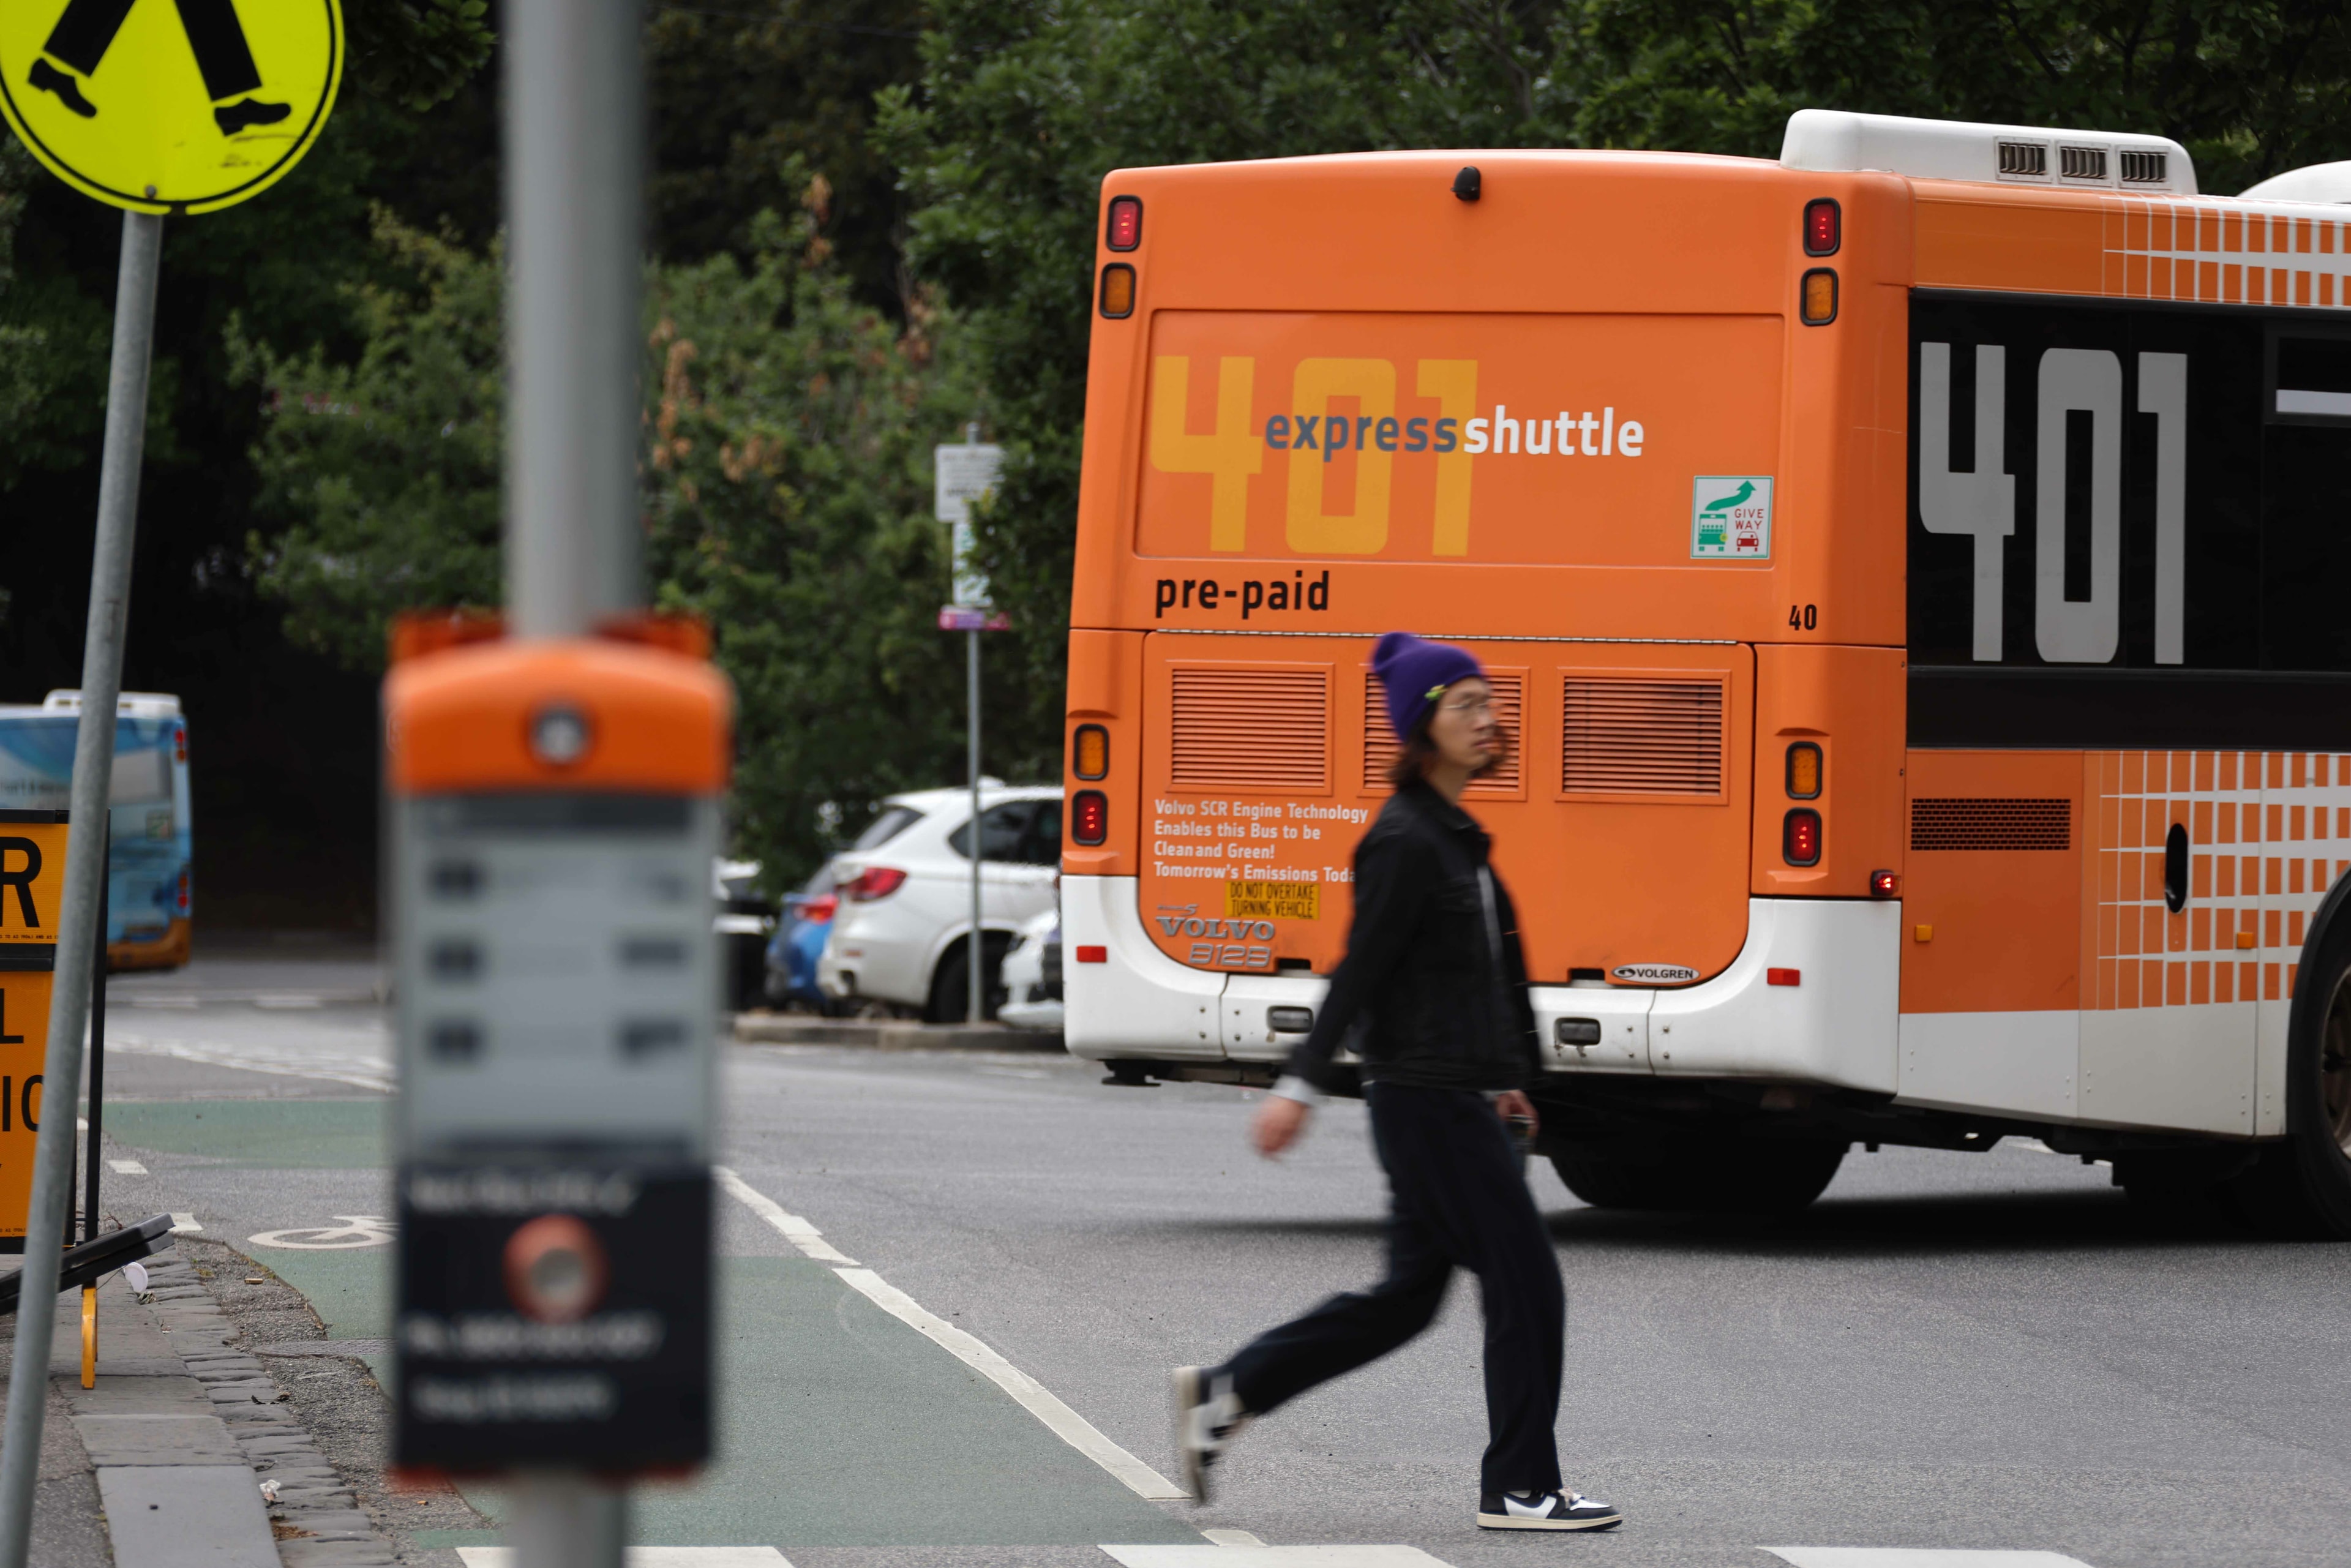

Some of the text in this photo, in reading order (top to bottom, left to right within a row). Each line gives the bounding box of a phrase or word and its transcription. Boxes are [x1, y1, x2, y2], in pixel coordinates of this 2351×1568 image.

[1150, 355, 1477, 557] 401
[1919, 342, 2188, 664] 401
[1734, 509, 1764, 519] GIVE
[1735, 520, 1762, 530] WAY
[1156, 570, 1329, 620] pre-paid
[1789, 604, 1817, 631] 40
[1155, 799, 1368, 823] Volvo SCR Engine Technology
[1154, 820, 1321, 840] Enables this Bus to be
[1154, 841, 1275, 858] Clean and Green!
[1153, 861, 1355, 882] Tomorrow's Emissions Toda
[1231, 882, 1314, 900] DO NOT OVERTAKE
[1232, 899, 1313, 918] TURNING VEHICLE
[1156, 917, 1275, 940] VOLVO
[1189, 943, 1270, 967] B12B
[1637, 968, 1693, 979] VOLGREN
